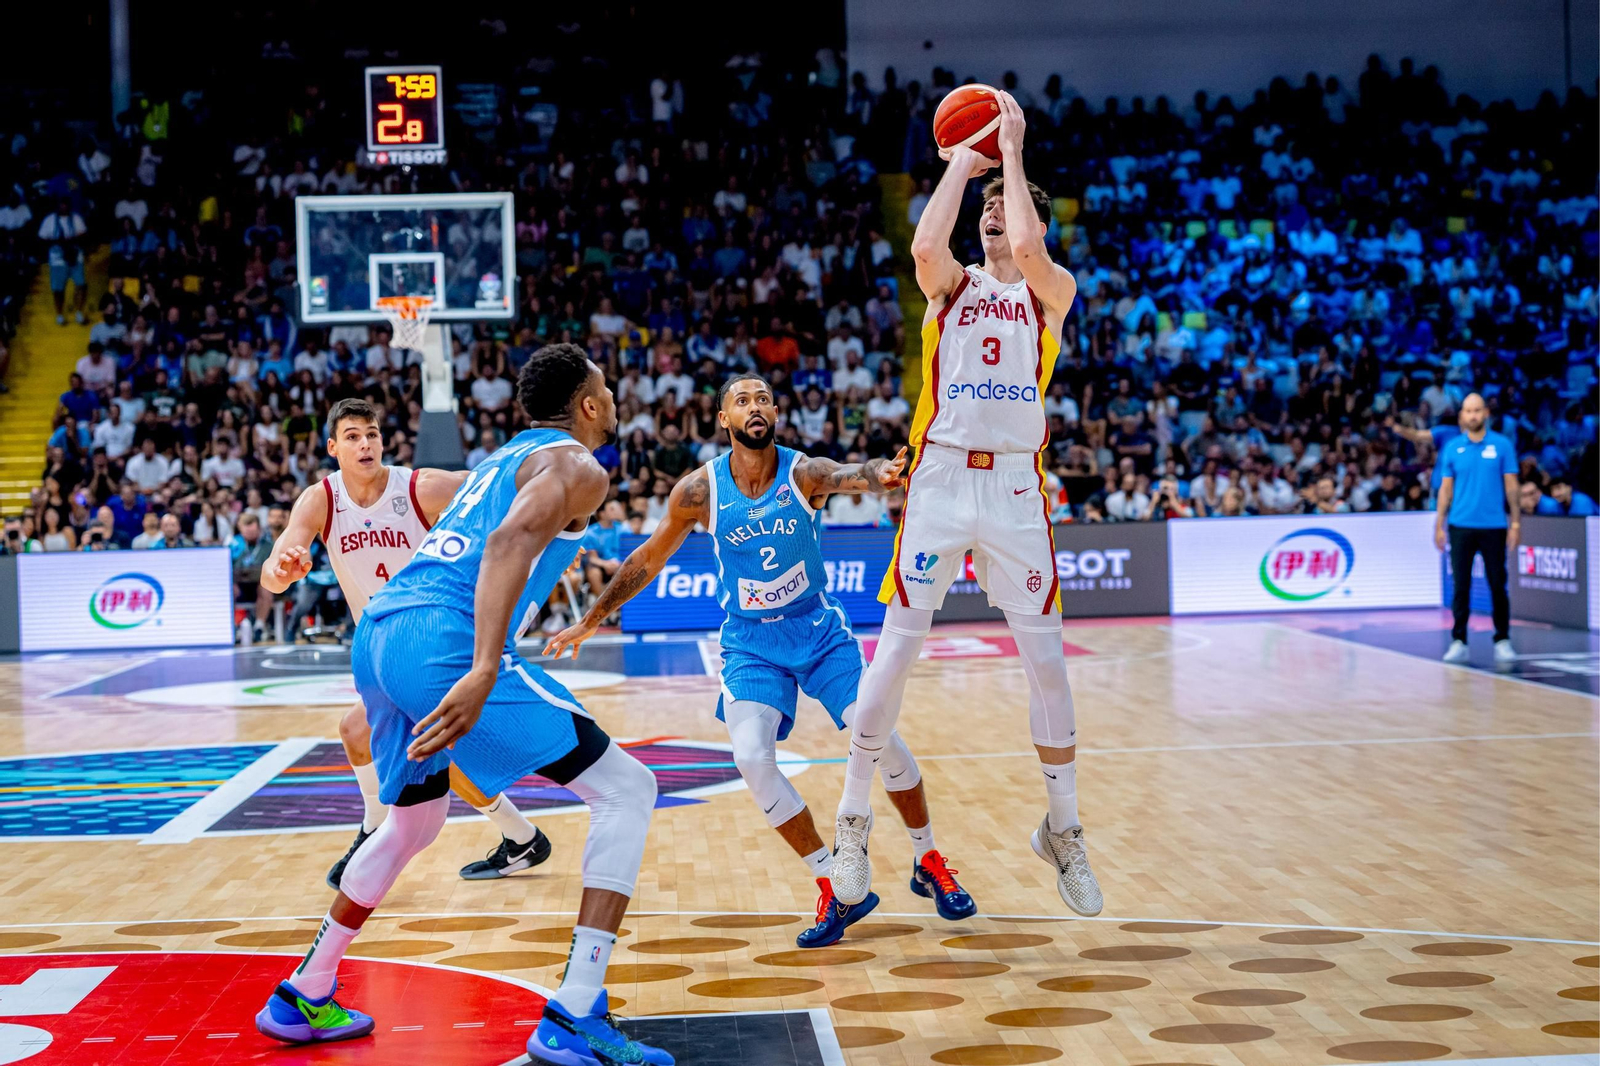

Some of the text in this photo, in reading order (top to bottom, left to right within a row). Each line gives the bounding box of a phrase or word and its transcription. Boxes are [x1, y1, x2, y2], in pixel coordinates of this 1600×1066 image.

[386, 75, 436, 99] 7:59
[377, 104, 423, 142] 2.8
[389, 150, 446, 164] TISSOT
[957, 298, 1029, 326] ESPAÑA
[982, 337, 1001, 366] 3
[947, 379, 1037, 402] endesa
[340, 527, 411, 554] ESPAÑA
[725, 518, 798, 547] HELLAS
[760, 546, 779, 571] 2
[1055, 548, 1132, 580] SOT
[1273, 549, 1339, 580] 伊利
[375, 563, 390, 583] 4
[100, 589, 153, 614] 伊利
